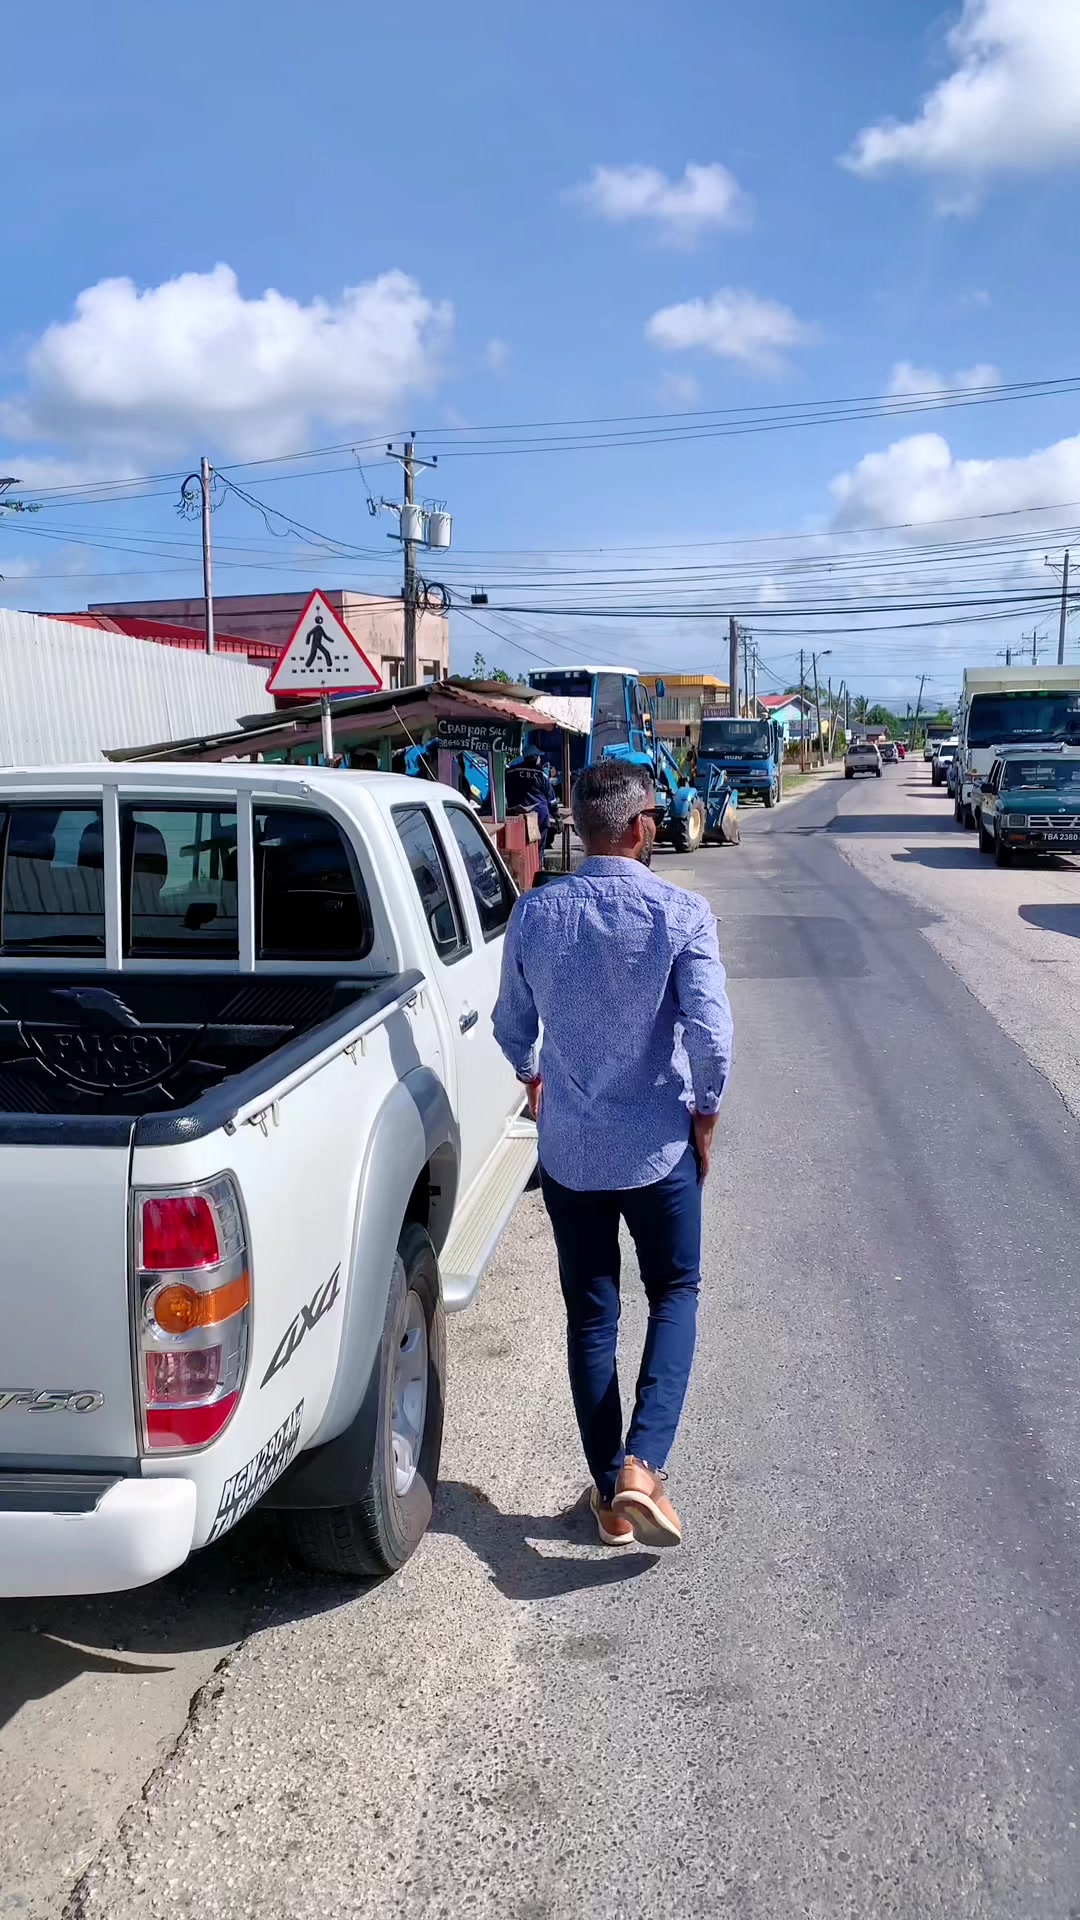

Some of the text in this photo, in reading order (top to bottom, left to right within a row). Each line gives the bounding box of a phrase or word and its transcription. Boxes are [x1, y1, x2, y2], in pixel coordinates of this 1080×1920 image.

[438, 720, 507, 737] CRAB FOR SALE
[471, 737, 490, 750] FREE
[1043, 833, 1059, 841] TBA
[53, 1034, 181, 1063] FALCON
